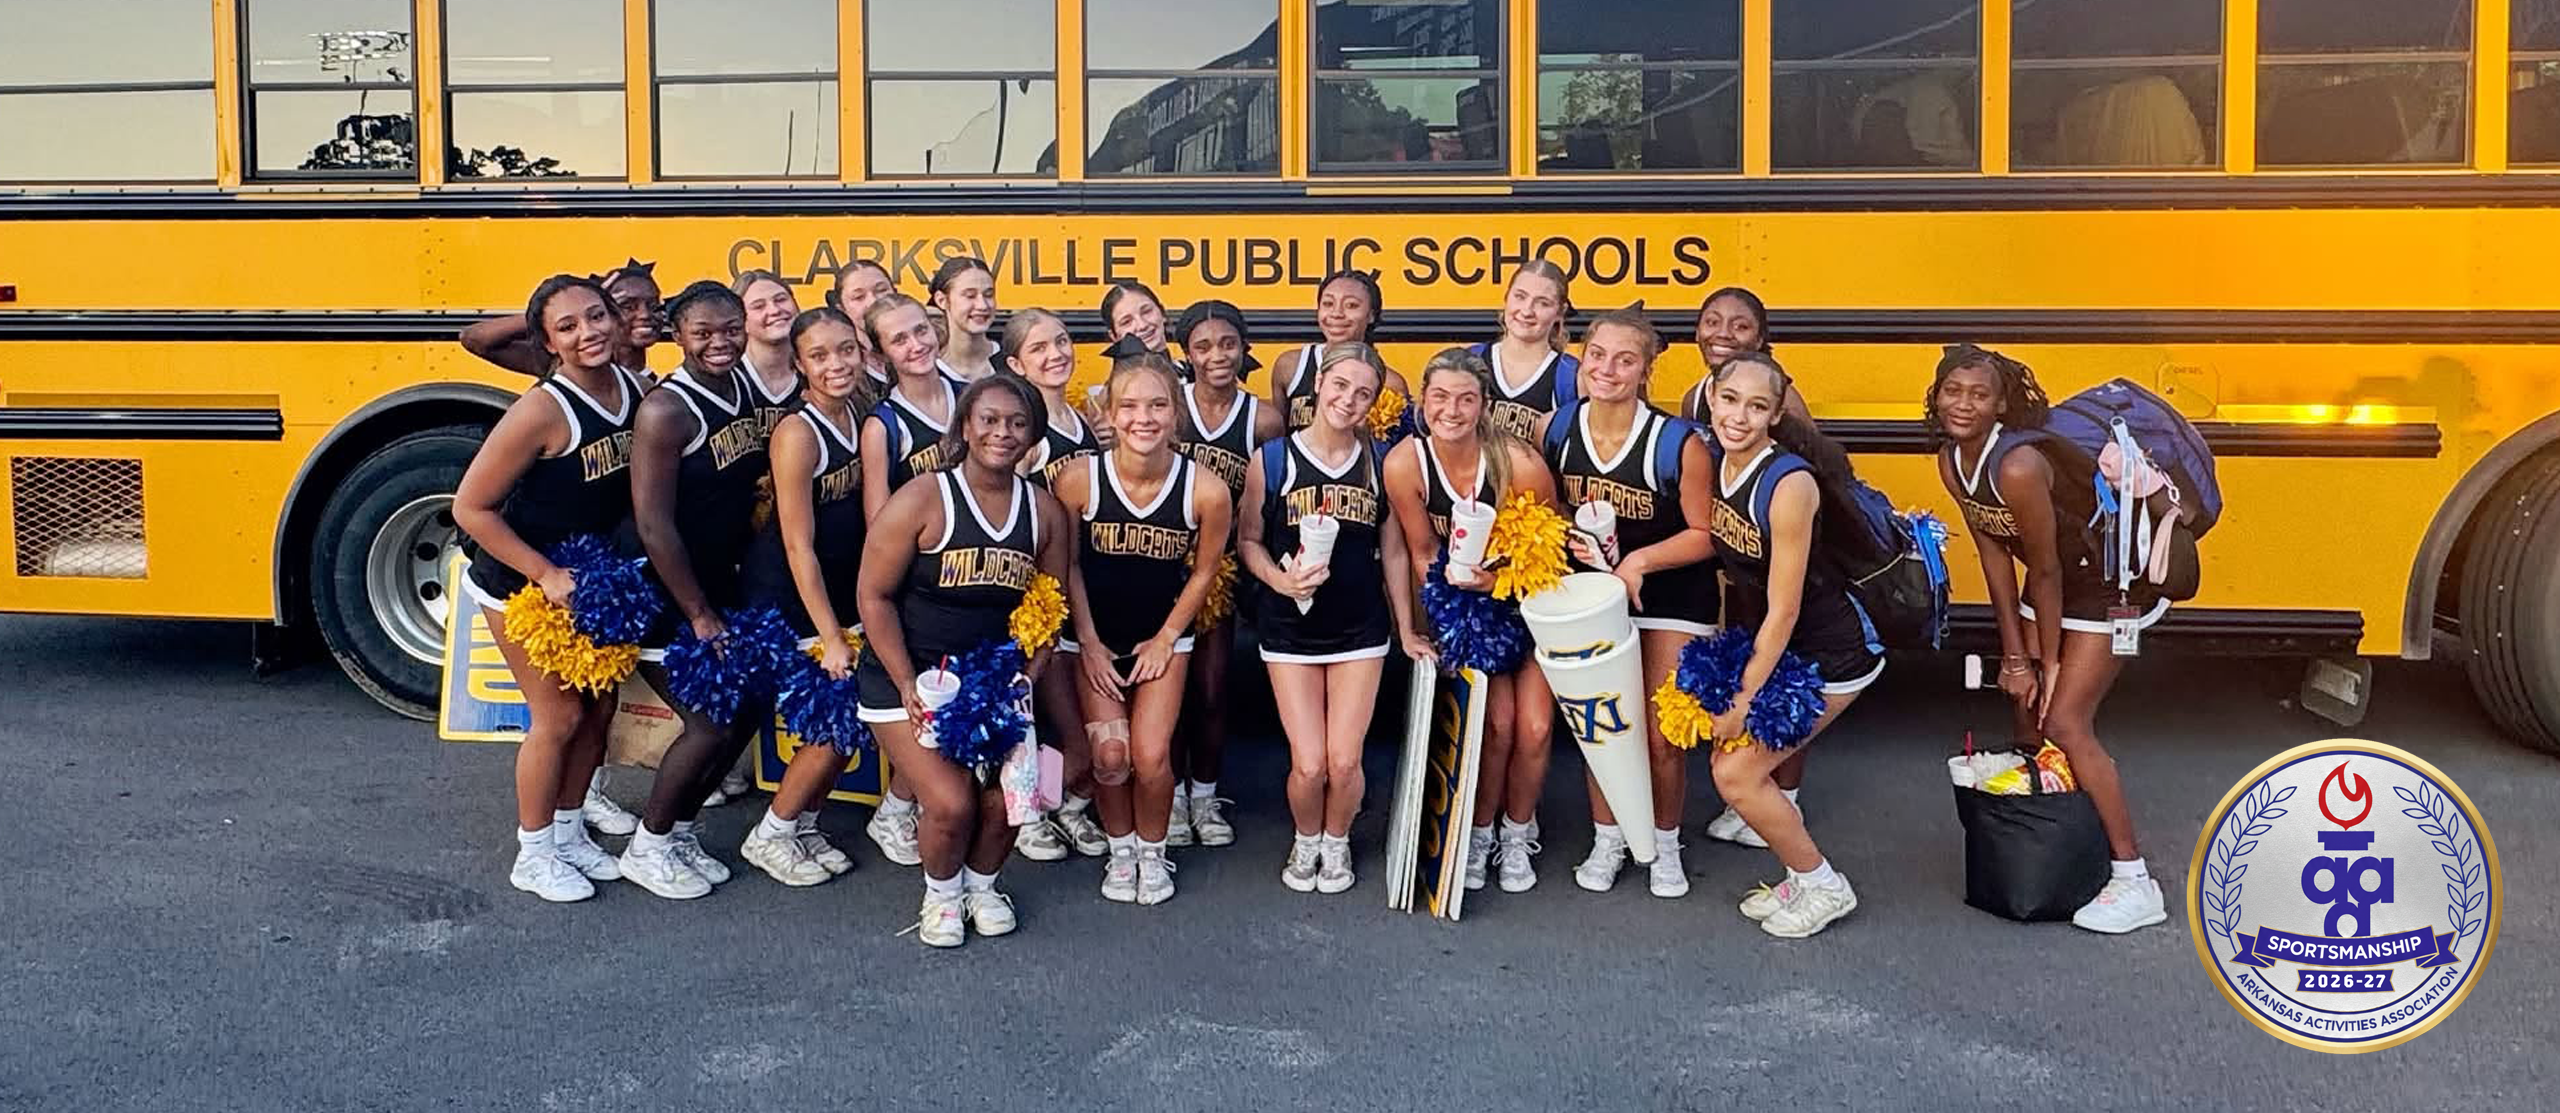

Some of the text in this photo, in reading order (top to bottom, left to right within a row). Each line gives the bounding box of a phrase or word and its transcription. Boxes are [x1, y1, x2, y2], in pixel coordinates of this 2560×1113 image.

[1160, 238, 1381, 286] PUBLIC
[1403, 237, 1710, 286] SCHOOLS
[1287, 484, 1379, 528] WILDCATS
[1092, 523, 1190, 559] WILDCATS
